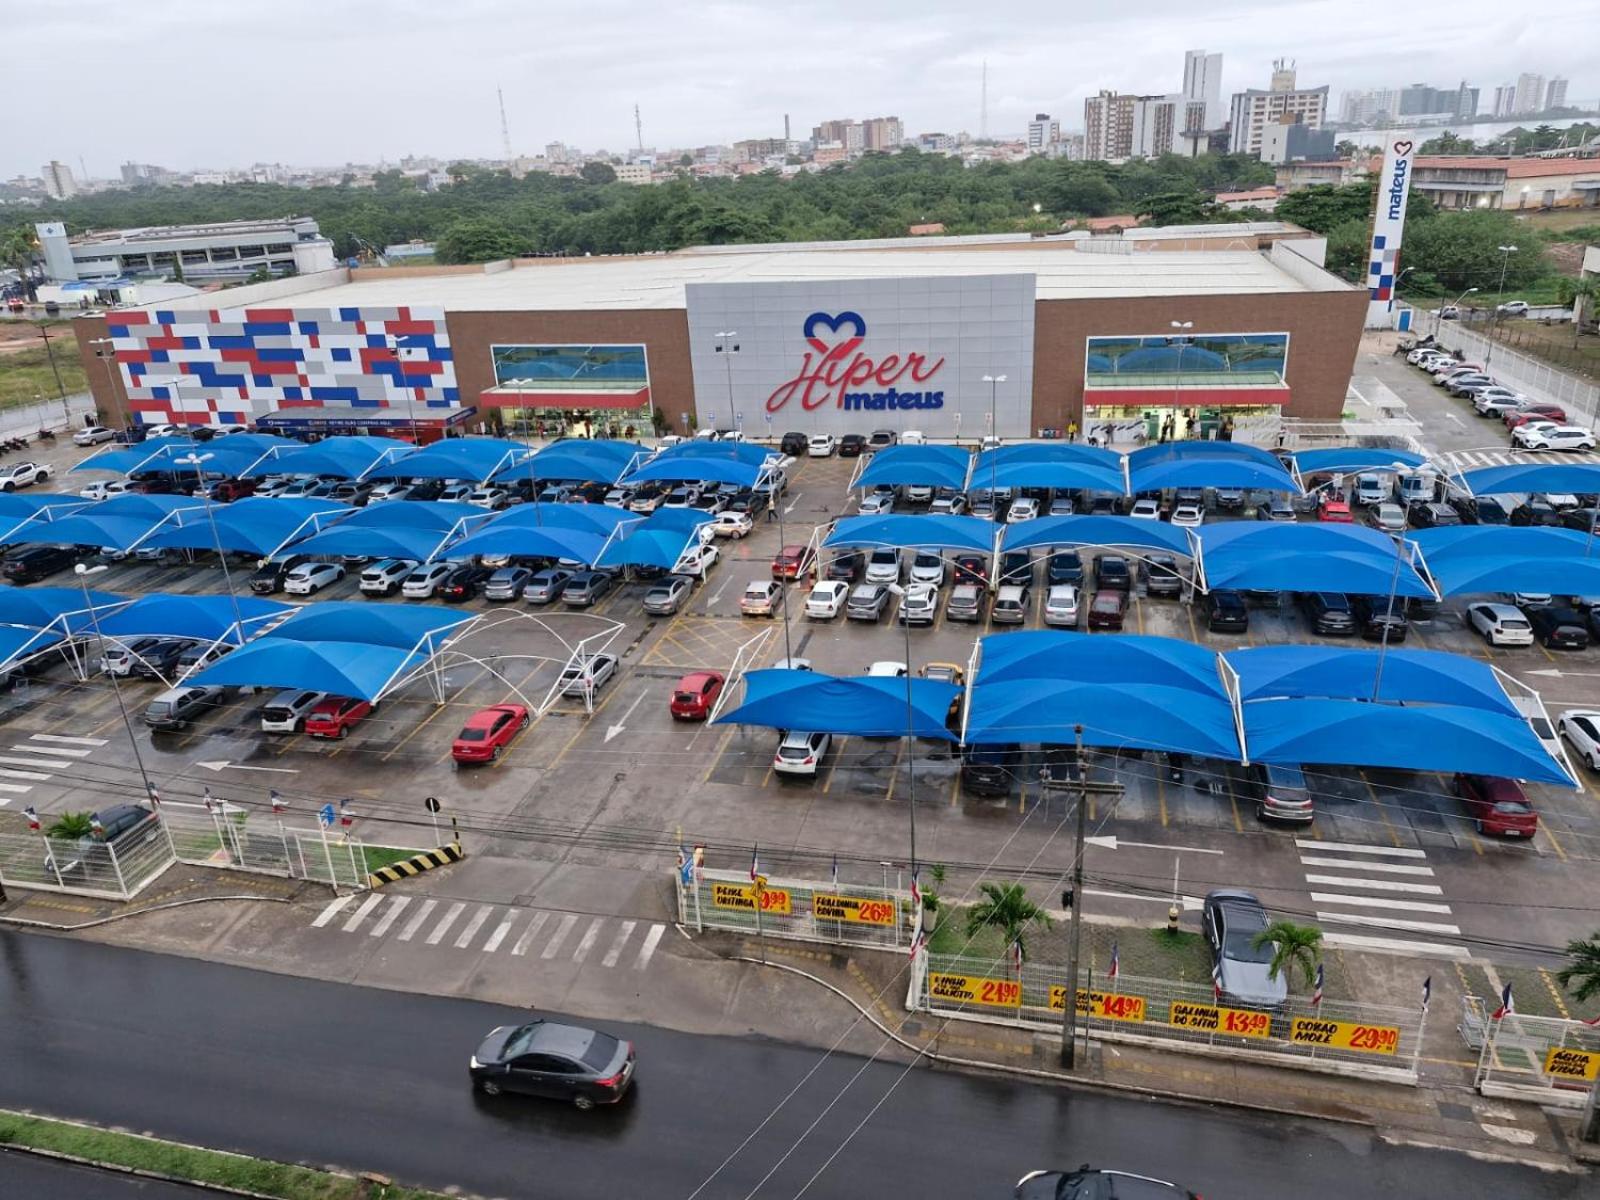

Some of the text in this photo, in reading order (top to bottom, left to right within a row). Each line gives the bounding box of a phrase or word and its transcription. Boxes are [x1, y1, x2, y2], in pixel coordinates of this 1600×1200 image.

[1388, 159, 1407, 220] mateus
[766, 343, 944, 412] Hiper
[844, 388, 944, 411] mateus
[1173, 1015, 1187, 1025] DO
[1174, 1004, 1219, 1019] GALINHA
